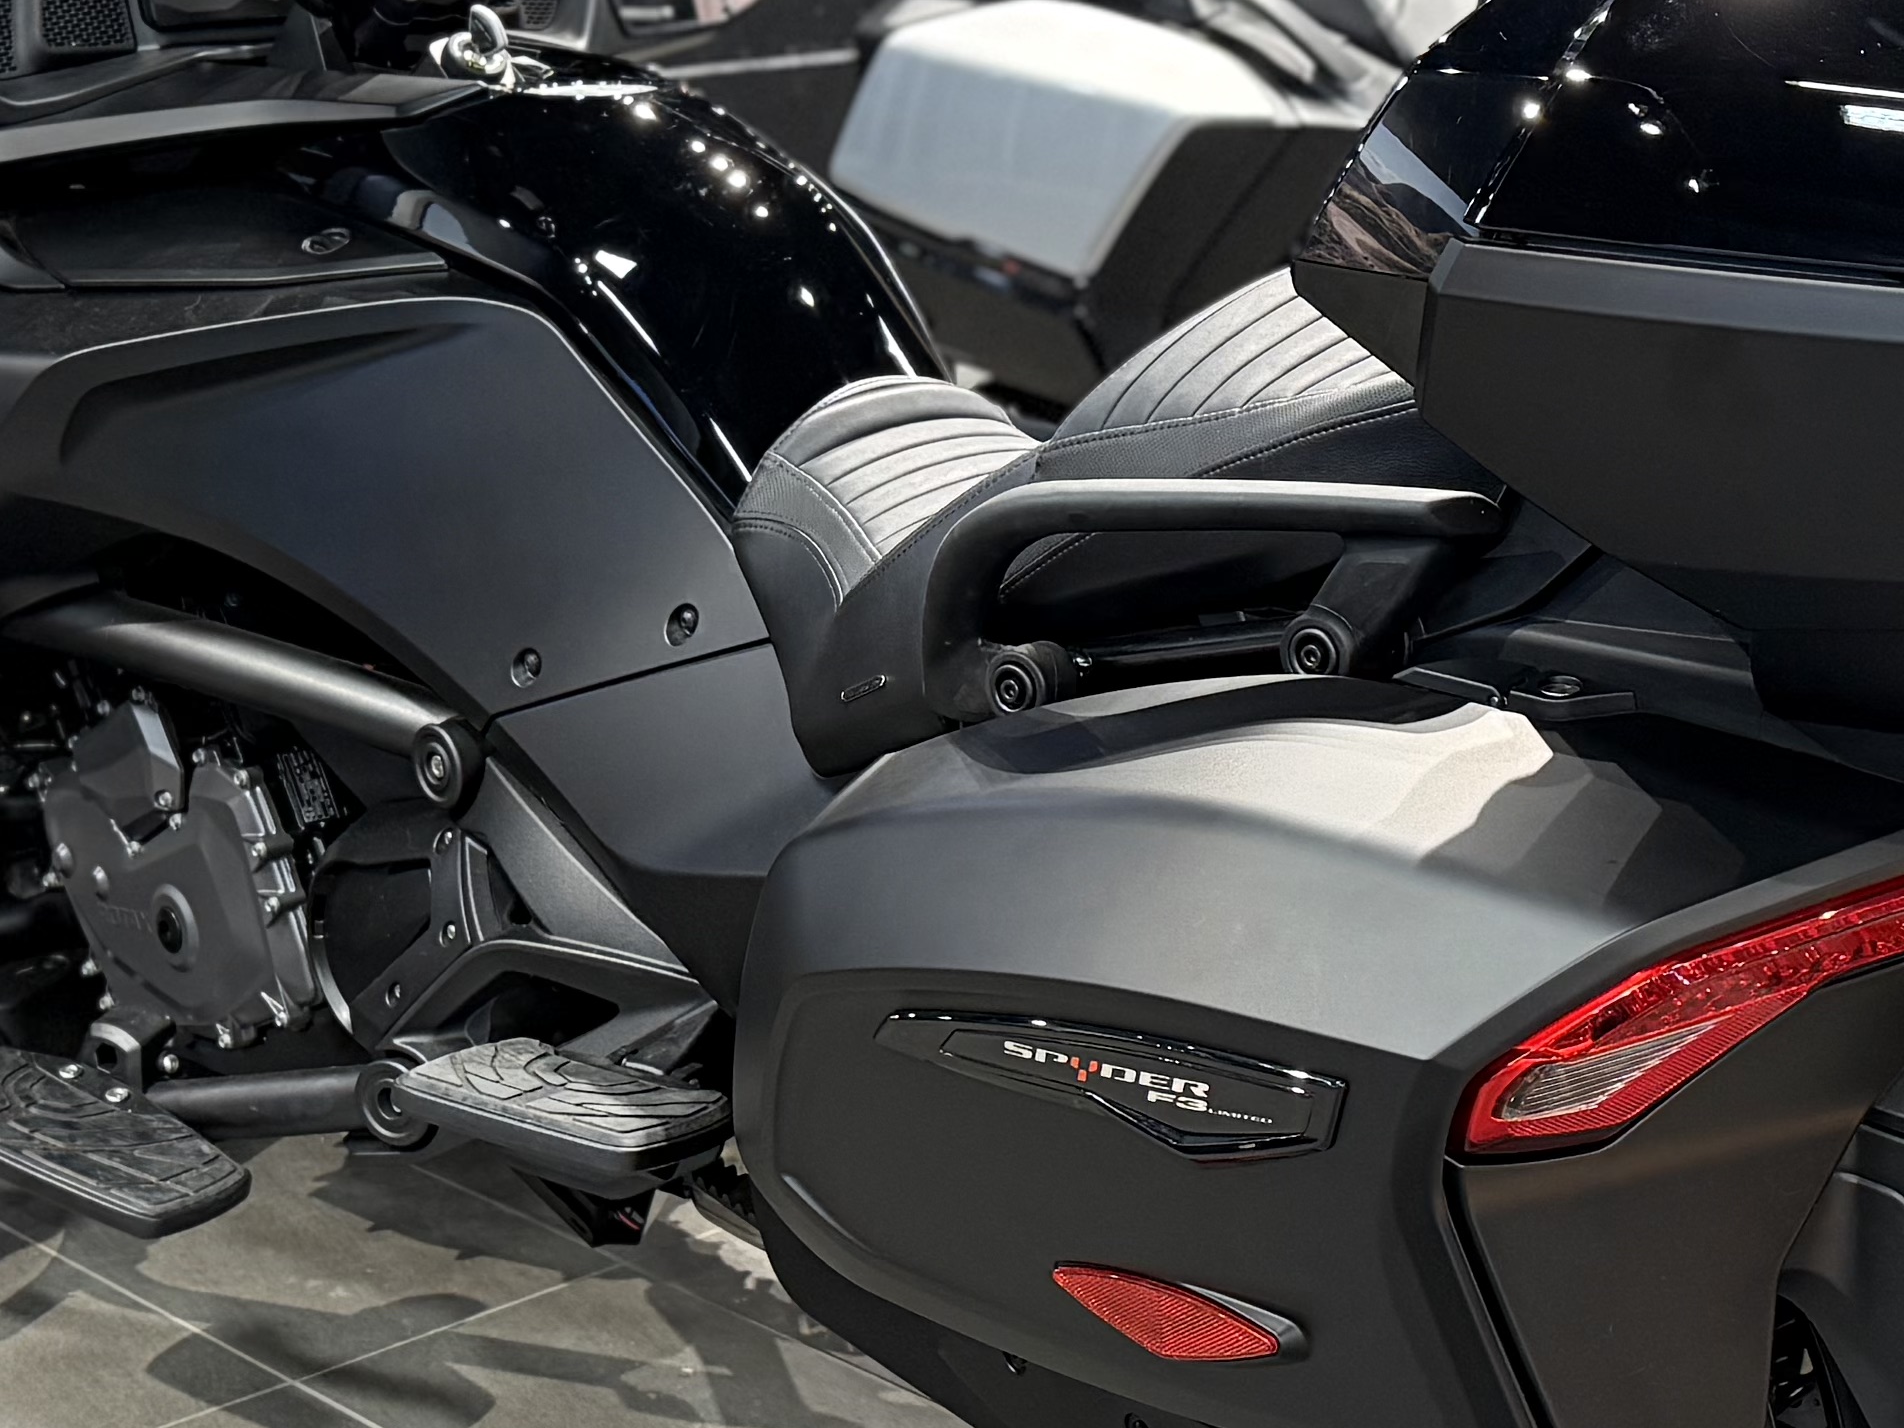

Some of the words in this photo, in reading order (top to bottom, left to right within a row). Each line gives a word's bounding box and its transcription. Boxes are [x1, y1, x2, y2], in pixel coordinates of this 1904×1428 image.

[1003, 1040, 1210, 1098] SPYDER
[1147, 1090, 1208, 1113] F3
[1208, 1107, 1273, 1124] LIMITED
